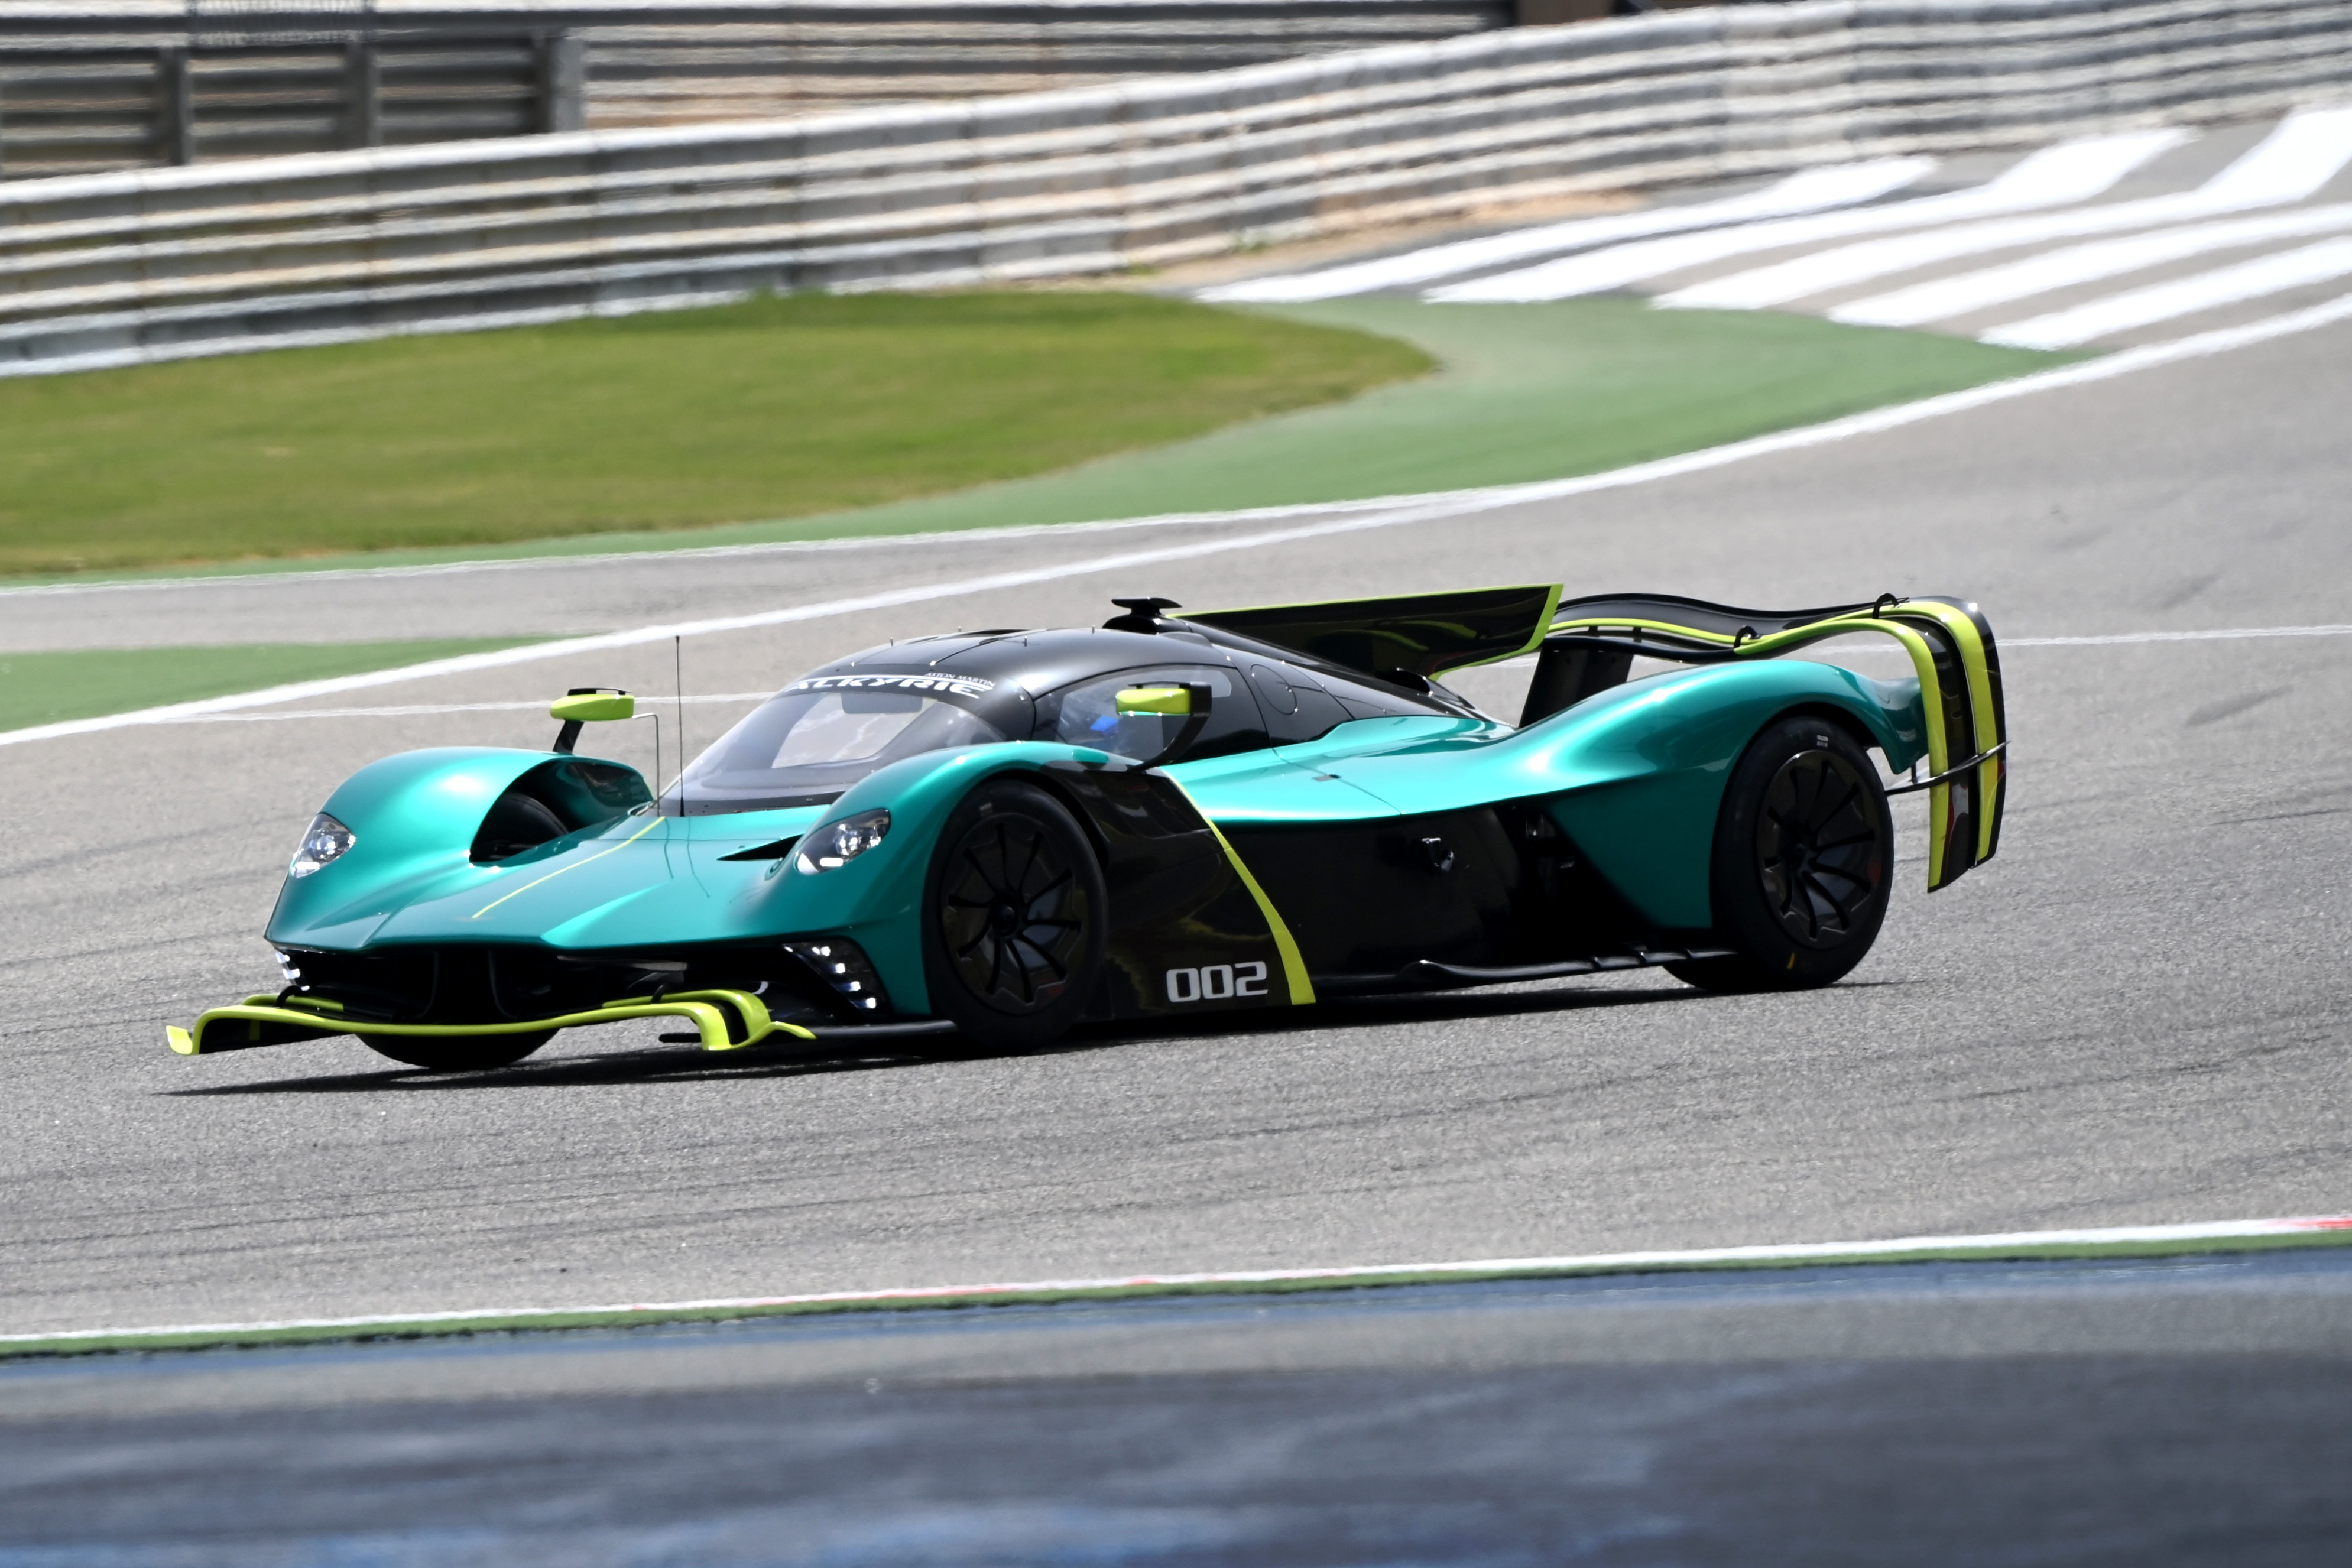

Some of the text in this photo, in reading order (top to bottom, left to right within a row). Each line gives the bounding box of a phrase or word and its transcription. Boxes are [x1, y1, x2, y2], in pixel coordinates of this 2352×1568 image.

[785, 675, 994, 699] ALKYRIE
[957, 675, 995, 687] MARTIN
[1166, 961, 1269, 1002] 002
